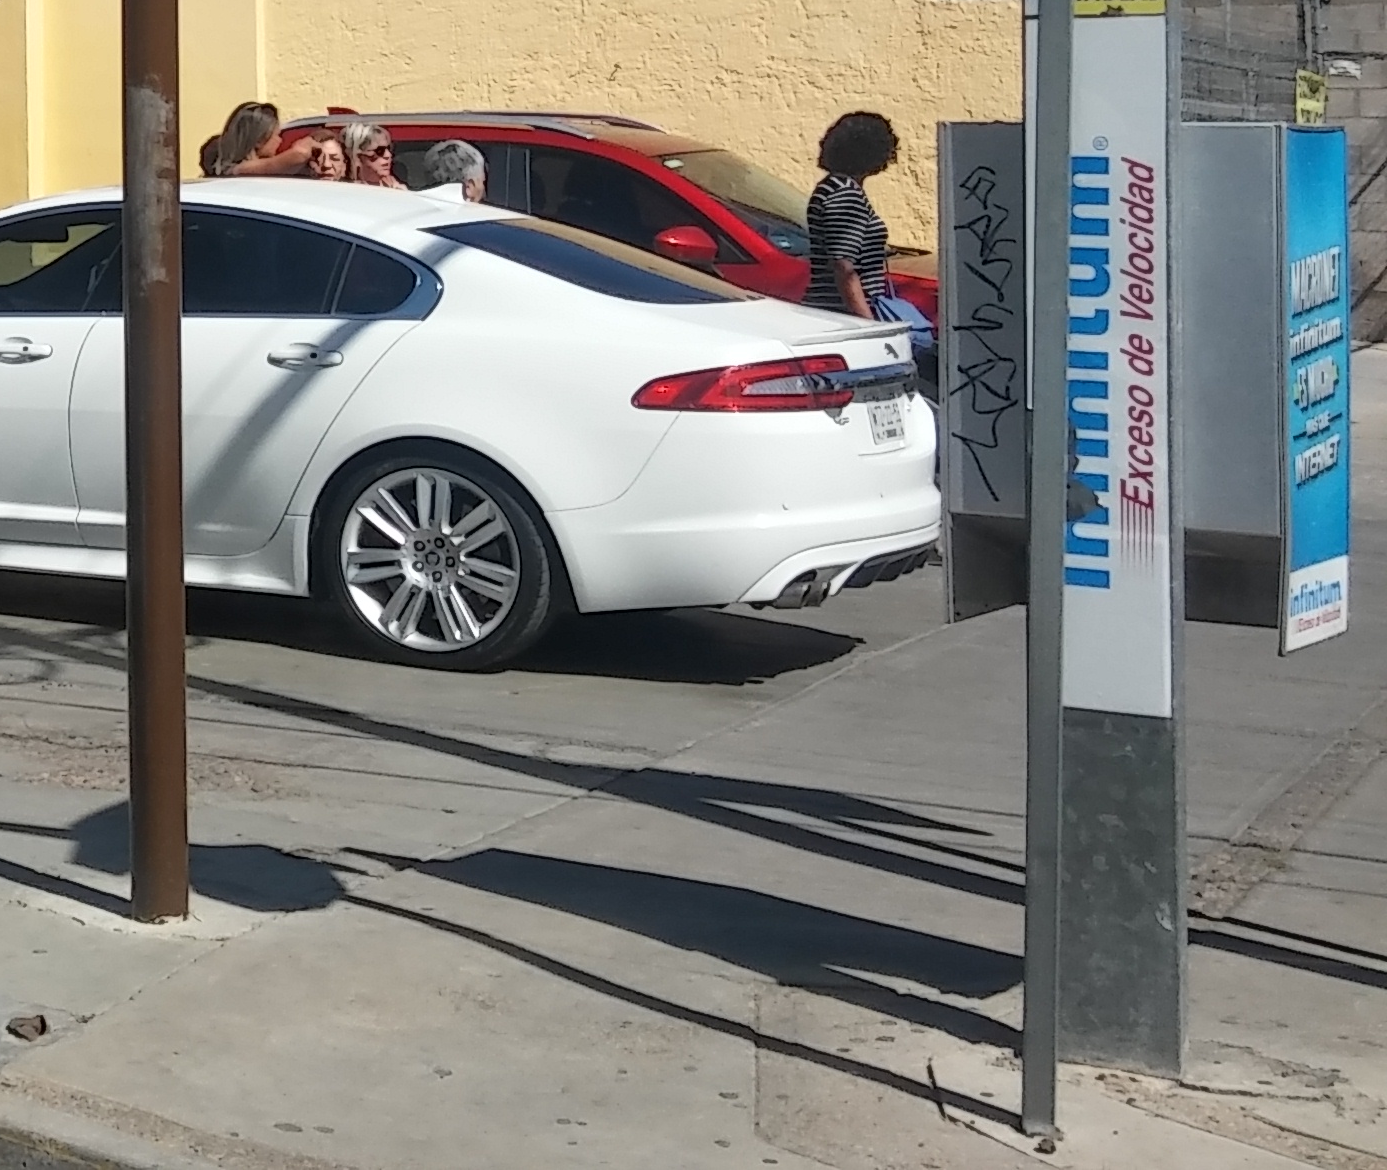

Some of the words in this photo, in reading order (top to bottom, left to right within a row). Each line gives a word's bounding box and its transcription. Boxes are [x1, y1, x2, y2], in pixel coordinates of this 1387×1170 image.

[1120, 157, 1155, 322] Velocidad
[1120, 333, 1155, 377] de
[1289, 317, 1342, 361] infinitum
[1120, 383, 1155, 510] Exceso
[1294, 432, 1340, 486] INTERNET
[1290, 580, 1342, 618] infinitum
